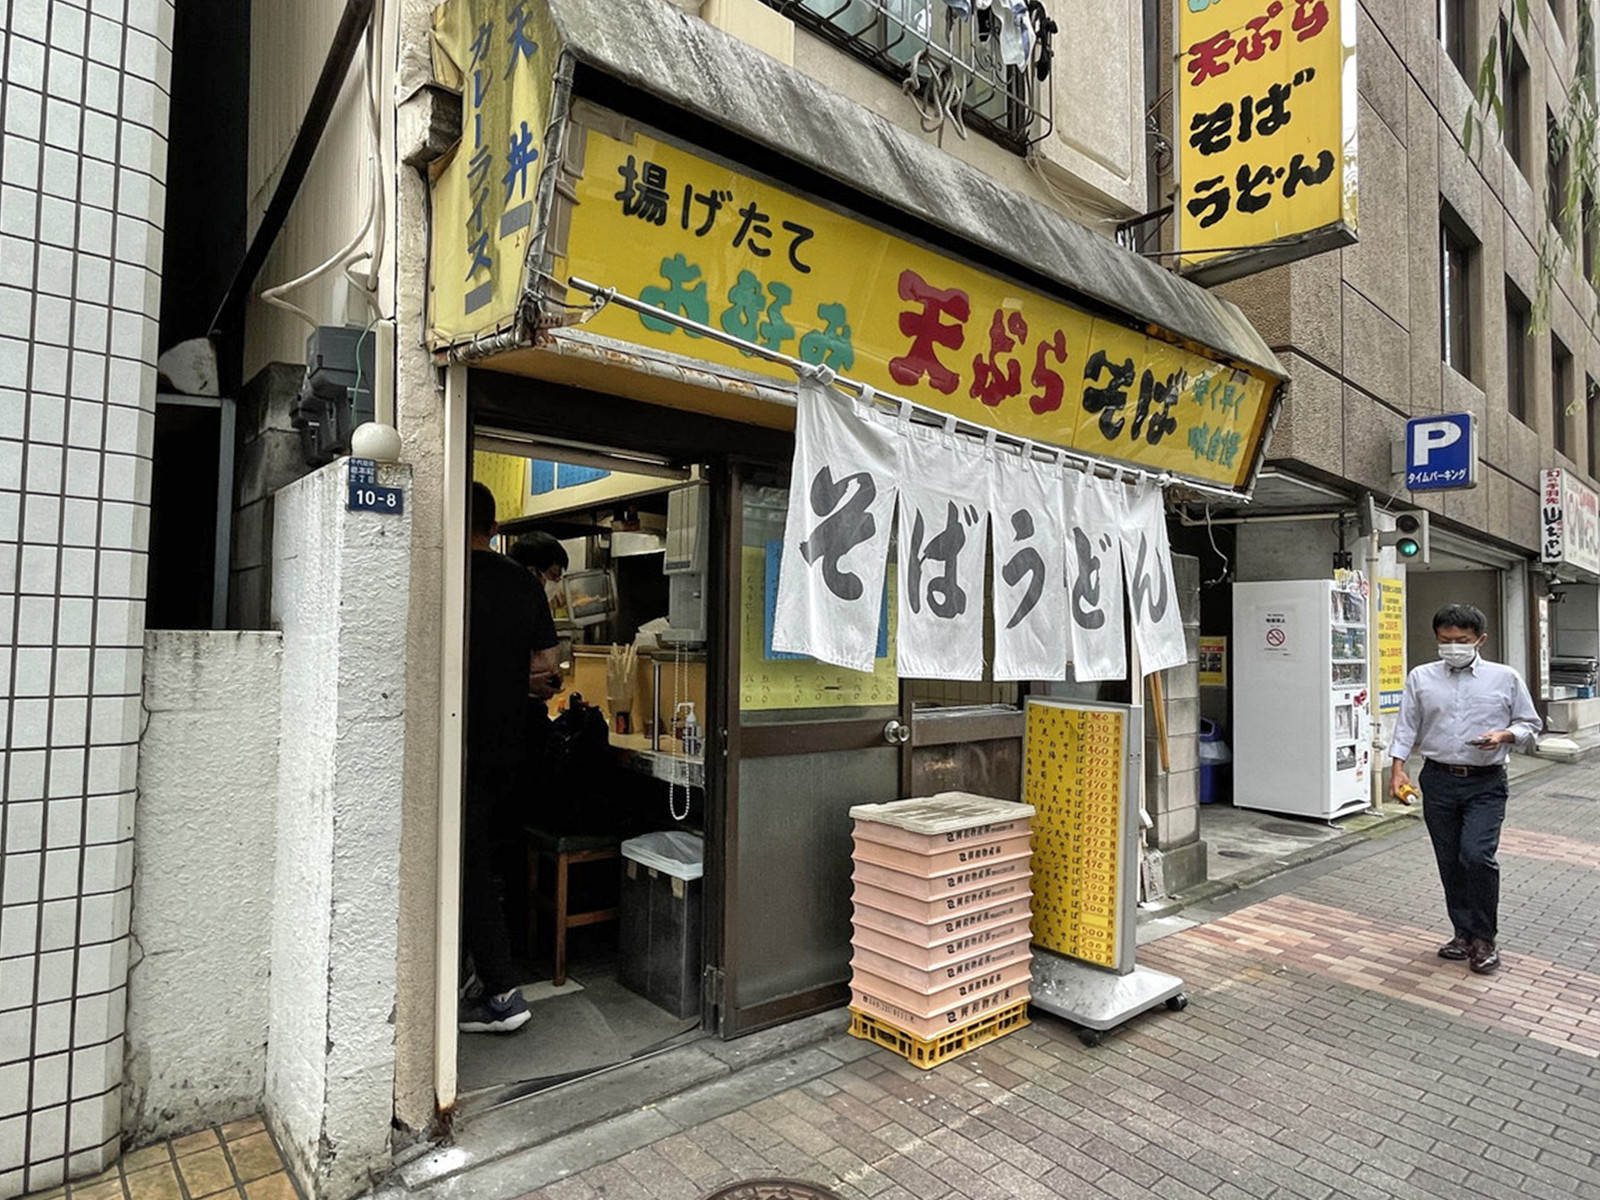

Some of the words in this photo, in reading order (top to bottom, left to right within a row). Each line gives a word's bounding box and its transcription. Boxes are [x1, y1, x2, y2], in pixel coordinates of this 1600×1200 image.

[464, 21, 494, 282] カレーライス
[1189, 67, 1316, 156] そば
[615, 154, 815, 274] 揚げたて
[1187, 149, 1335, 230] うどん
[638, 252, 856, 376] お好み
[888, 268, 1068, 415] 天ぷら
[1083, 349, 1188, 446] そば
[1407, 467, 1467, 485] タイムパーキング
[1413, 421, 1462, 467] P
[356, 489, 397, 508] 10-8
